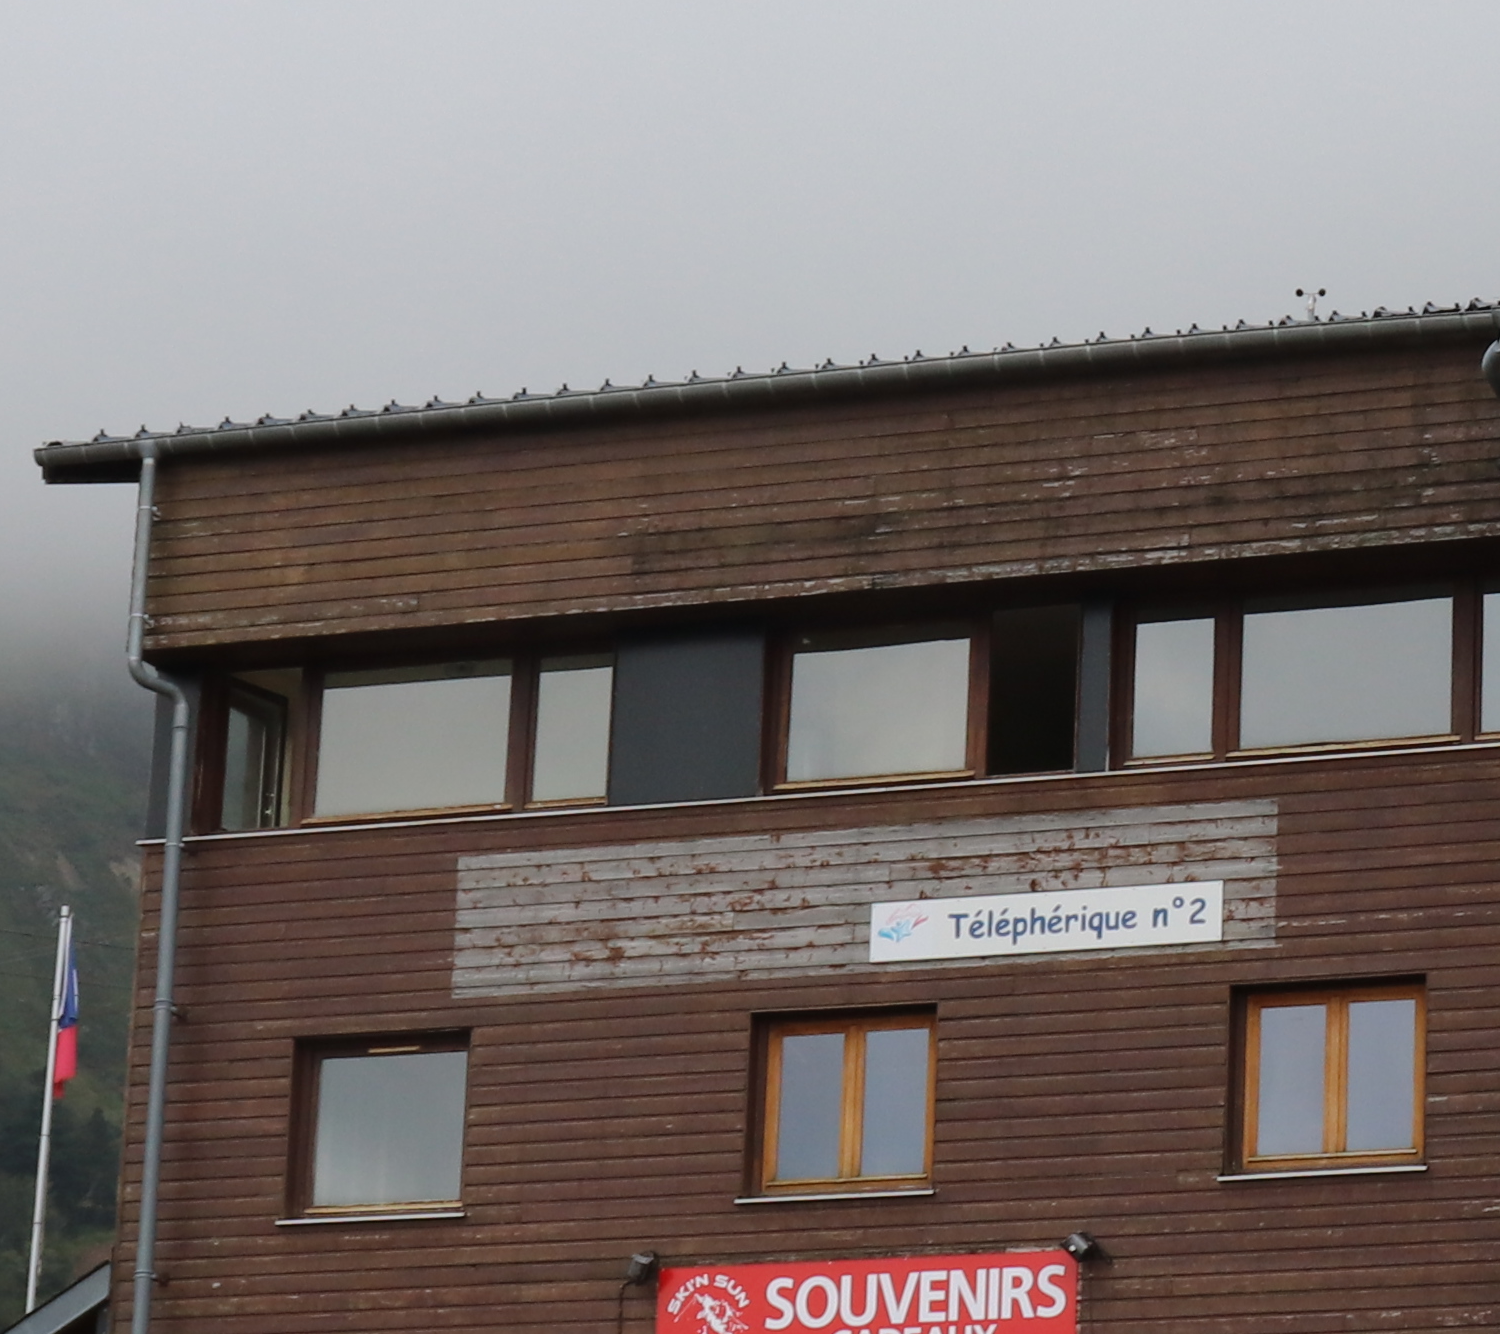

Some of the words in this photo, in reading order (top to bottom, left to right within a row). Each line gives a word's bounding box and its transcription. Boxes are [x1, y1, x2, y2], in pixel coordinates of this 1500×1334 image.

[948, 904, 1138, 945] Téléphérique
[667, 1273, 710, 1316] SKI'N
[713, 1274, 750, 1308] SUN
[764, 1264, 1067, 1330] SOUVENIRS
